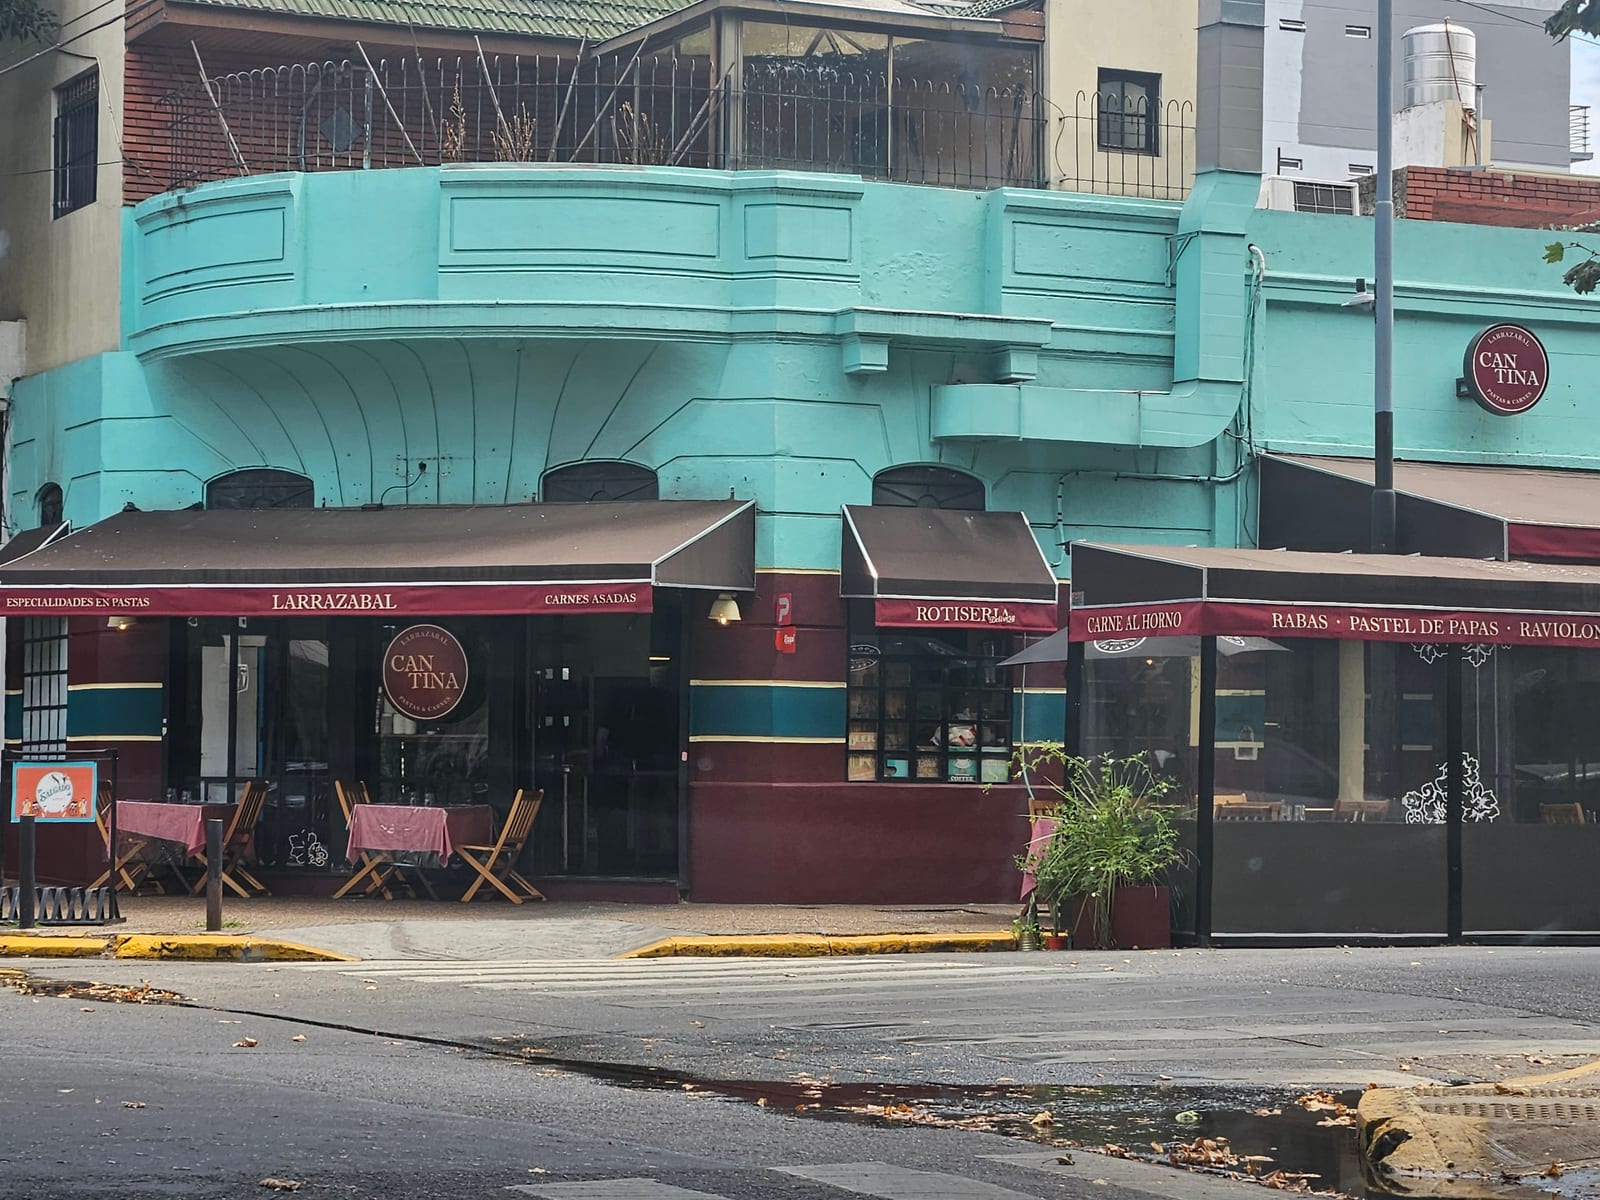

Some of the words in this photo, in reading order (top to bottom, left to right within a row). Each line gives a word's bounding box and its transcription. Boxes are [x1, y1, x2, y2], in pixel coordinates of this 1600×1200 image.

[1487, 331, 1530, 347] LARRAZABAL
[1479, 351, 1517, 368] CAN
[1494, 368, 1540, 386] TINA
[1486, 388, 1505, 404] PASTAS
[1511, 391, 1532, 405] CARNES
[6, 597, 93, 608] ESPECIALIDADES
[96, 597, 110, 607] EN
[112, 597, 151, 608] PASTAS
[272, 593, 398, 611] LARRAZABAL
[544, 594, 590, 605] CARNES
[592, 592, 637, 604] ASADAS
[1087, 616, 1123, 633] CARNE
[1125, 615, 1140, 630] AL
[1142, 611, 1182, 629] HORNO
[1272, 612, 1329, 629] RABAS
[1350, 615, 1417, 634] PASTEL
[1420, 619, 1445, 635] DE
[1450, 620, 1499, 636] PAPAS
[400, 631, 448, 646] LARRAZABAL
[391, 654, 434, 672] CAN
[408, 672, 459, 689] TINA
[399, 695, 420, 711] PASTAS
[427, 697, 451, 712] CARNES
